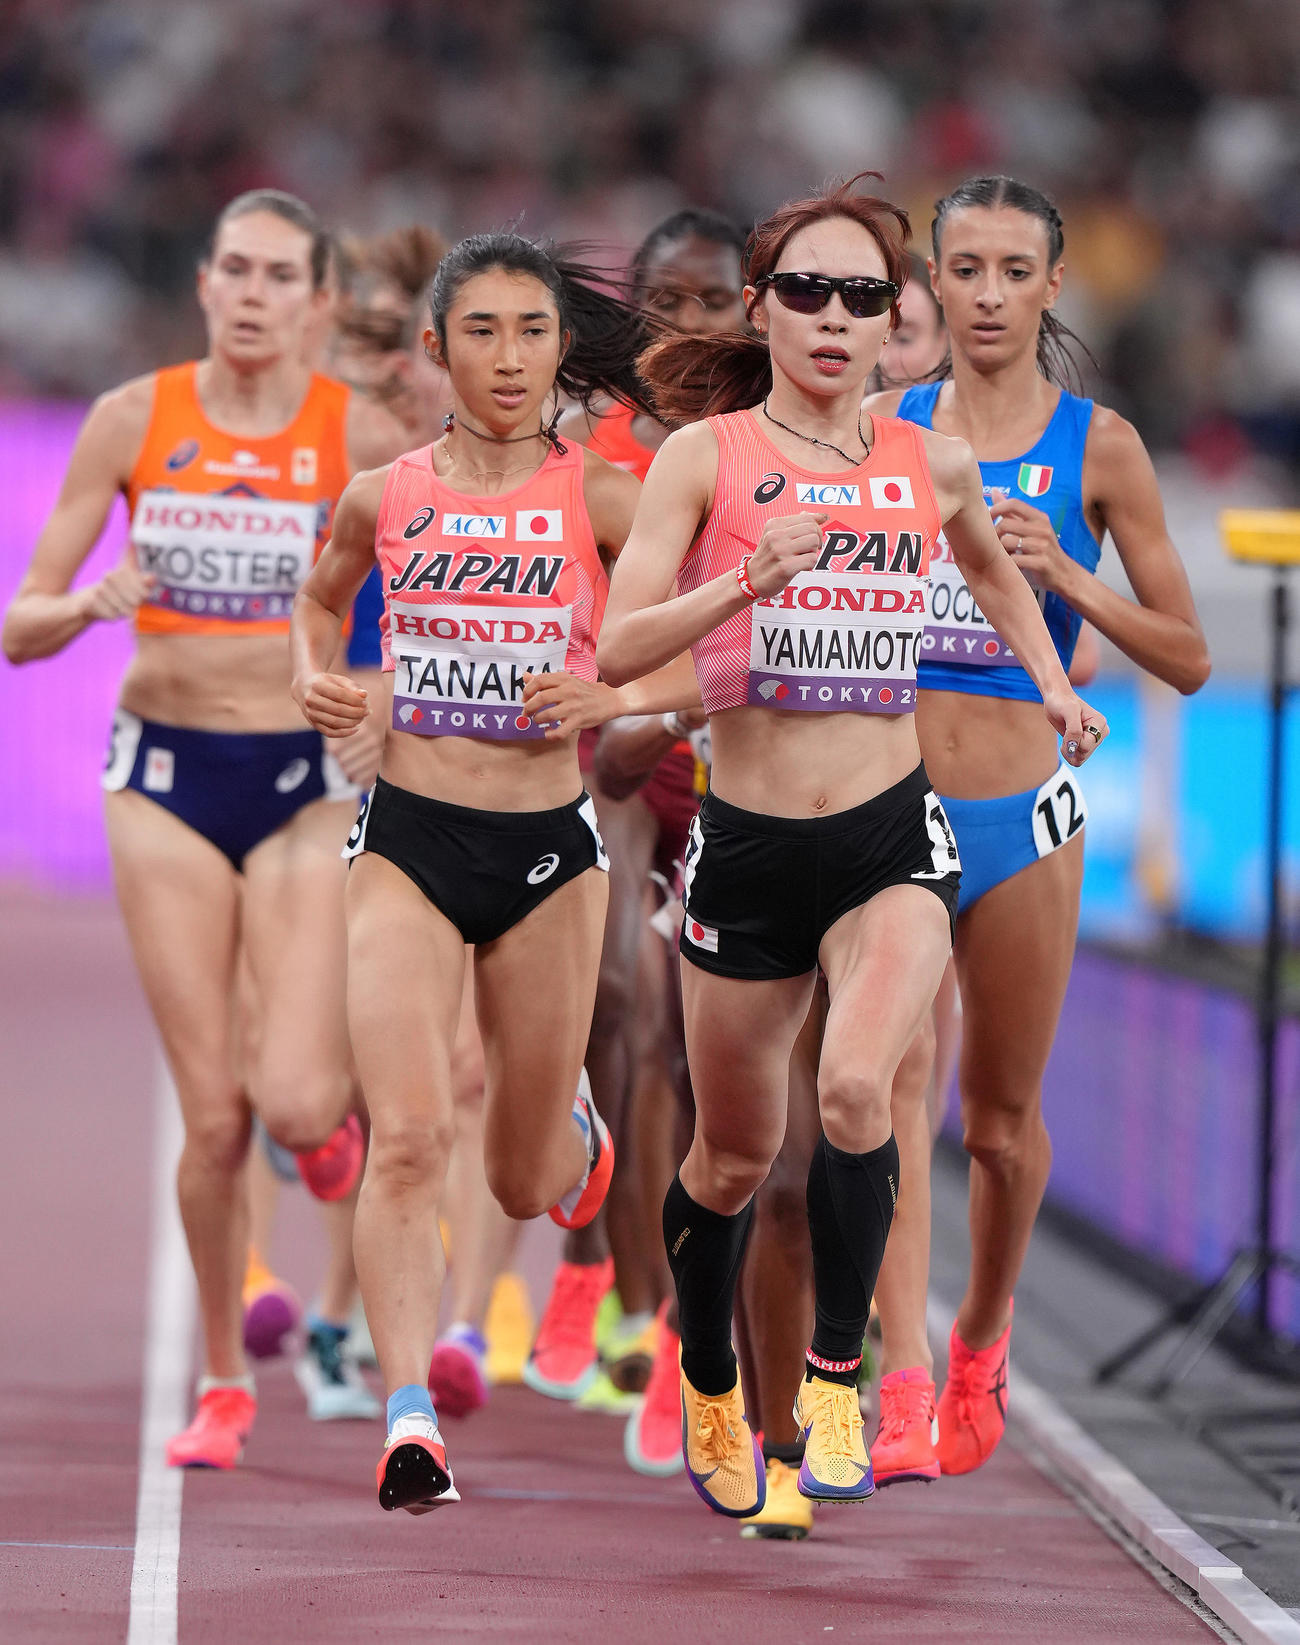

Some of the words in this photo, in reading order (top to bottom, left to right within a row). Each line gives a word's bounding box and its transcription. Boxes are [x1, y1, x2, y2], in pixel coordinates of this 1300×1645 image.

[801, 486, 856, 504] ACN
[144, 506, 305, 537] HONDA
[446, 516, 504, 536] ACN
[812, 532, 922, 574] PAN
[390, 552, 566, 598] JAPAN
[393, 612, 567, 644] HONDA
[798, 685, 894, 704] TOKYO
[431, 710, 532, 731] TOKYO
[1037, 780, 1085, 849] 12
